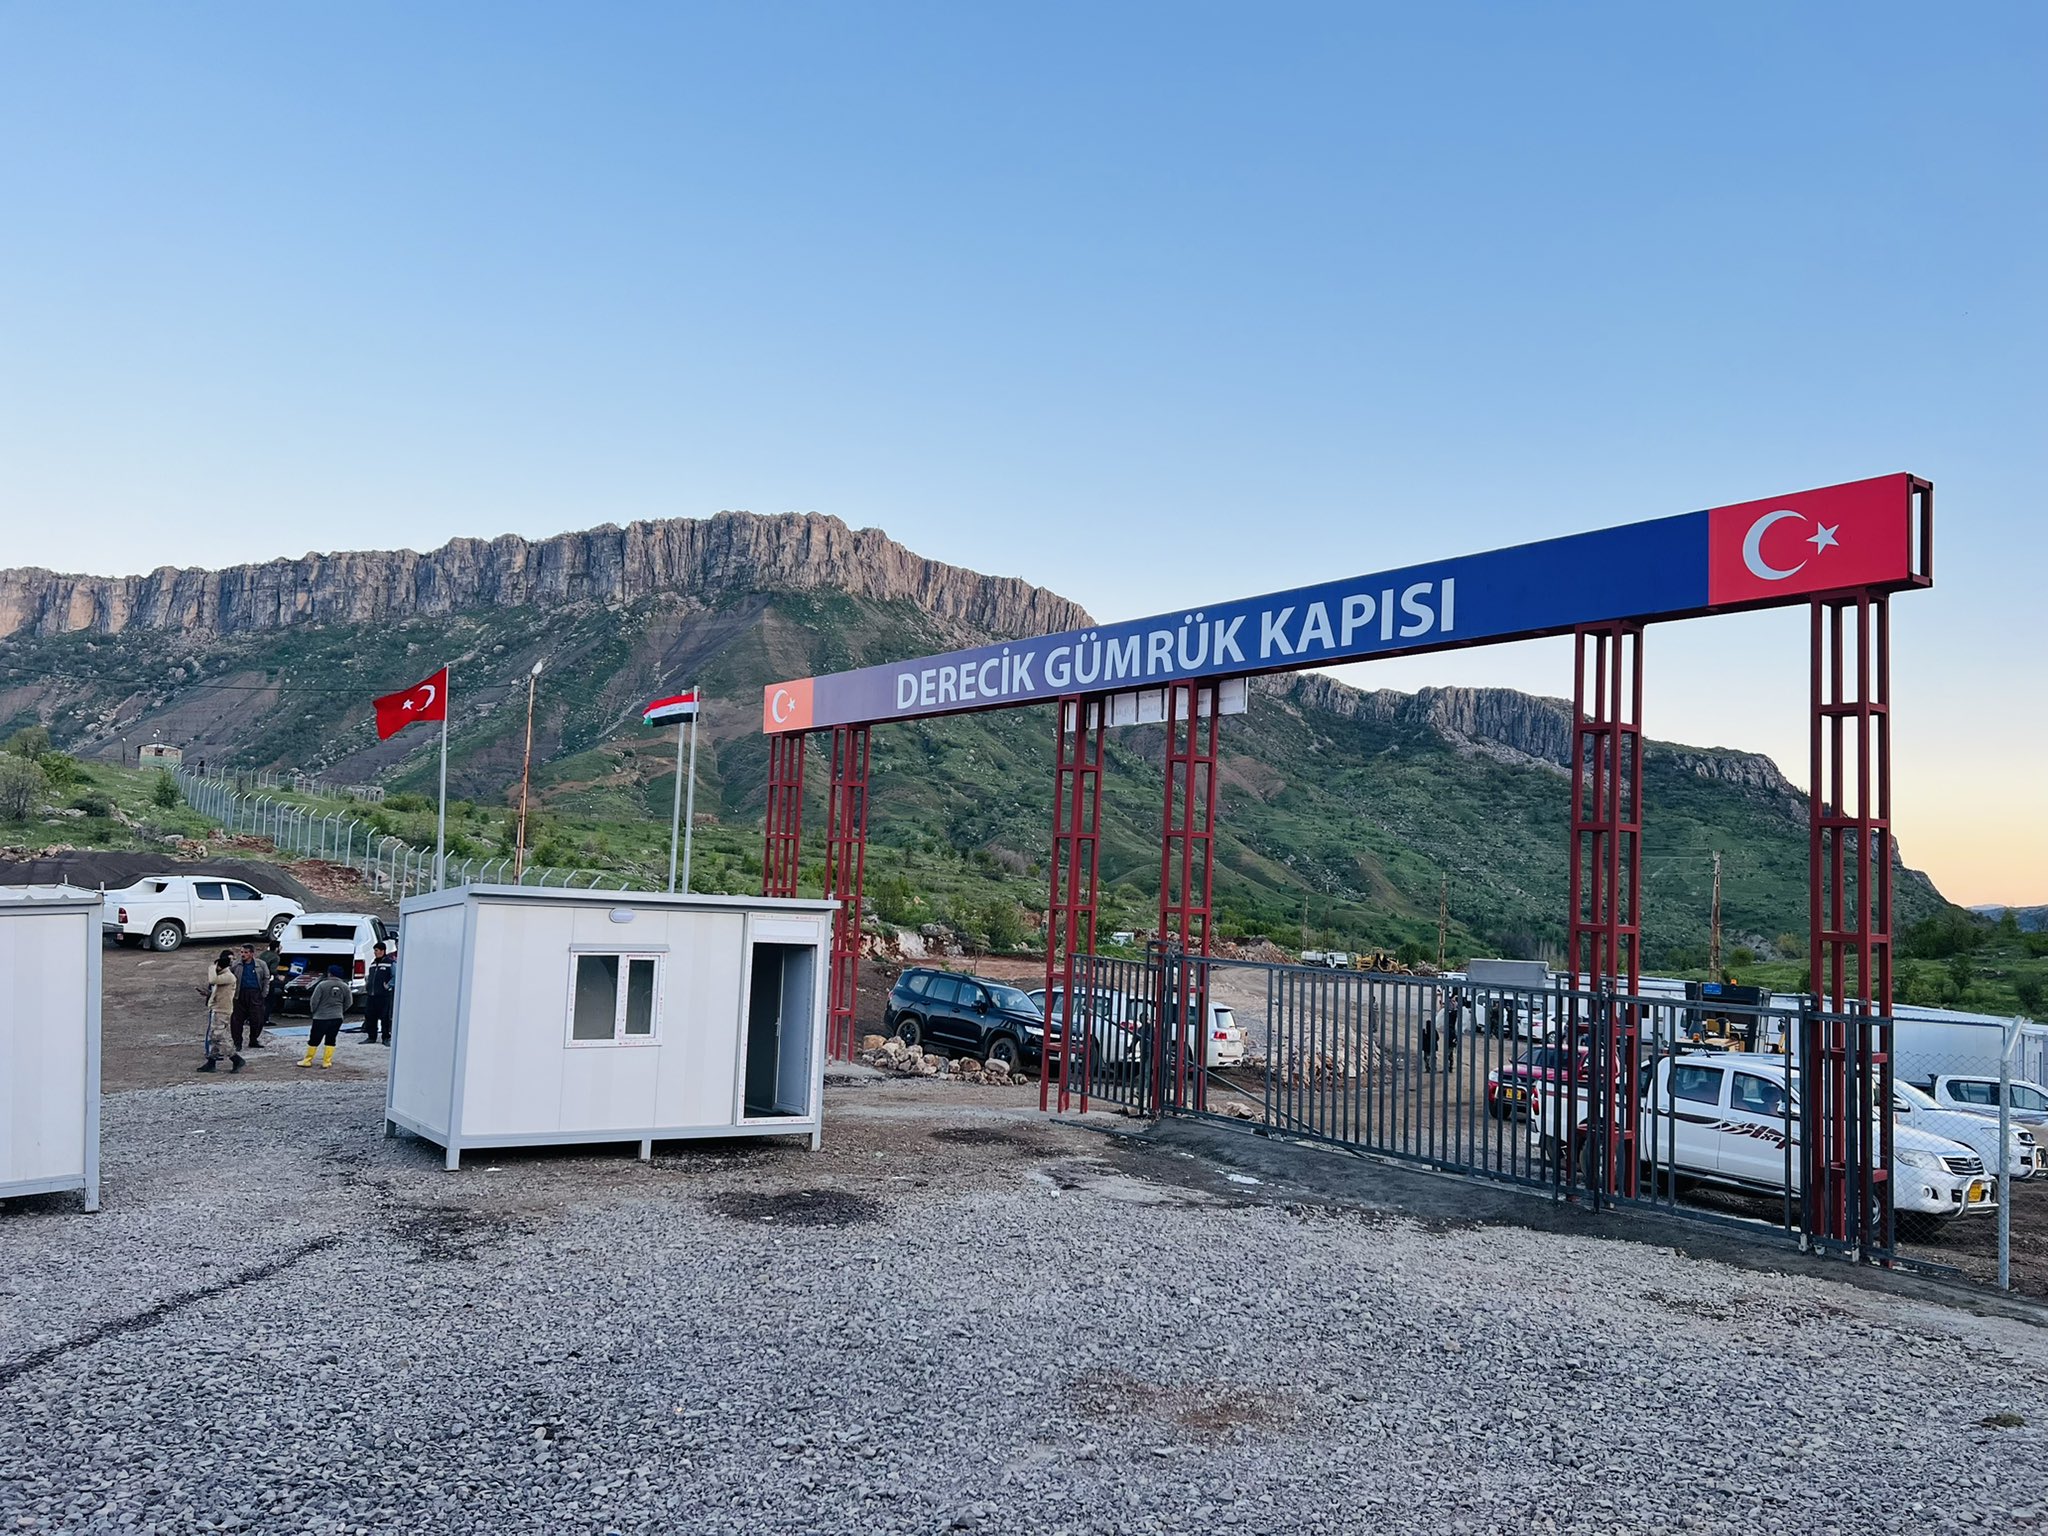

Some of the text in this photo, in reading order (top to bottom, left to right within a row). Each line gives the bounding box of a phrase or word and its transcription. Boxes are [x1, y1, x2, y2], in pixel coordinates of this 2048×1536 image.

[896, 647, 1036, 710] DERECİK
[1043, 613, 1246, 688] GÜMRÜK
[1260, 578, 1455, 659] KAPISI
